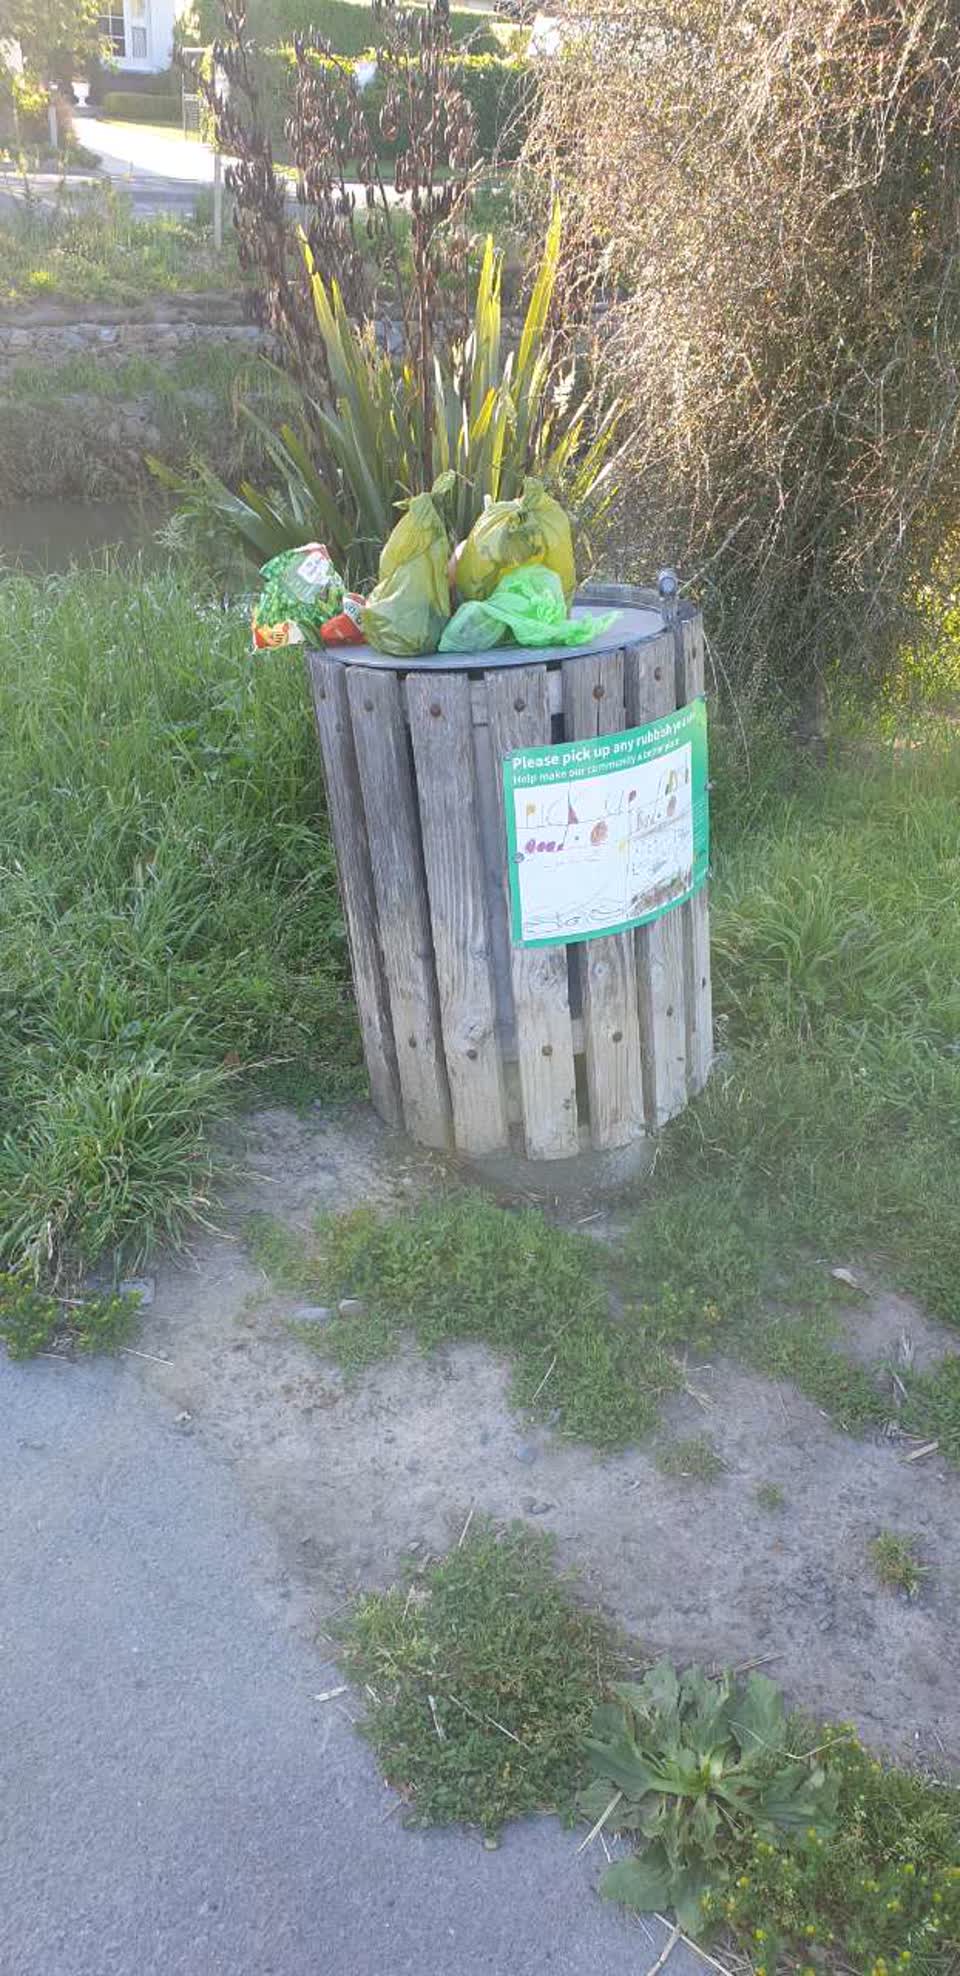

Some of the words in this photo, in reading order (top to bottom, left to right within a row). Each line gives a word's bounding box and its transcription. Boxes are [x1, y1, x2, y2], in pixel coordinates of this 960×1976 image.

[512, 754, 560, 769] Please
[562, 748, 591, 765] pick
[593, 745, 610, 758] up
[613, 739, 634, 753] any
[636, 725, 672, 746] rubbish
[512, 774, 537, 785] Help
[539, 770, 567, 782] make
[569, 767, 585, 777] our
[587, 755, 636, 775] community
